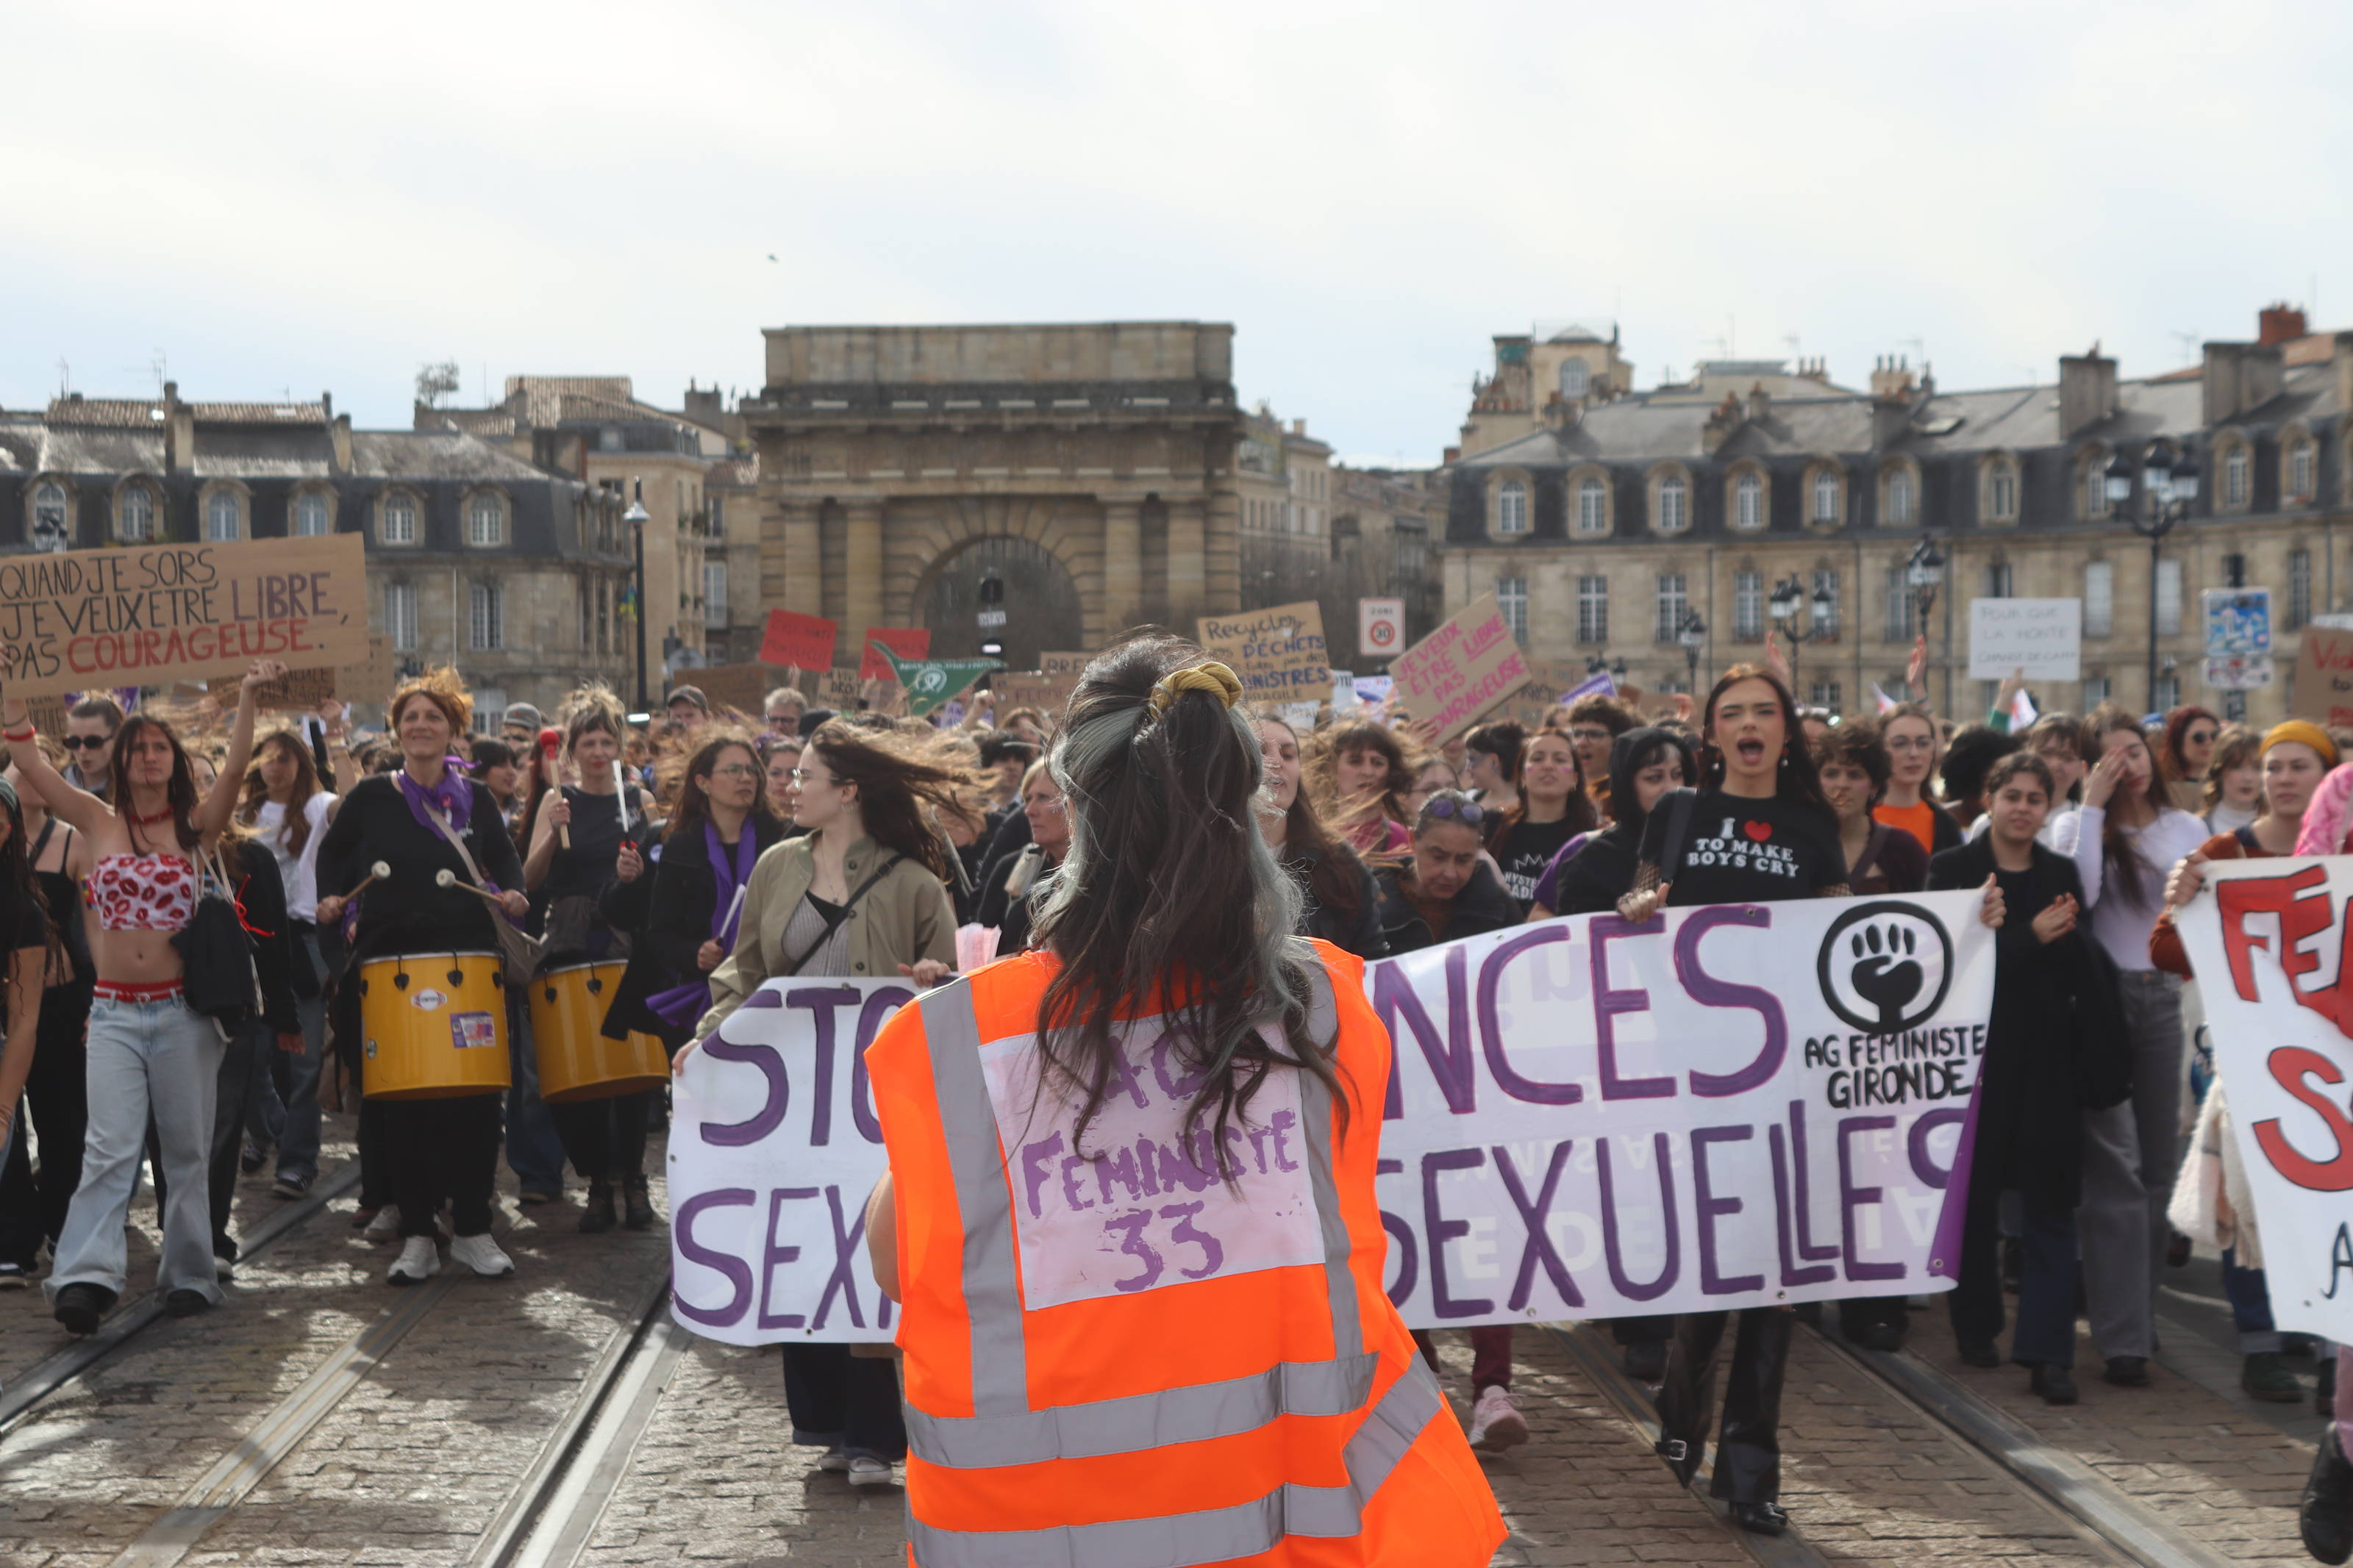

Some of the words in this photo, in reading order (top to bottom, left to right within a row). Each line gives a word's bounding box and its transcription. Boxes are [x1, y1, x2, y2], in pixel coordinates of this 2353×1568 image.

[0, 559, 82, 600] QUAND
[87, 556, 132, 594] JE
[1, 601, 56, 640] JE
[54, 593, 143, 636] VEUX
[1377, 627, 1392, 640] 30
[1243, 635, 1325, 659] DÉCHETS
[1415, 620, 1463, 661] VEUX
[6, 638, 60, 680] PAS
[1433, 671, 1465, 703] PAS
[1720, 817, 1735, 840] I
[1688, 851, 1747, 868] BOYS
[1754, 857, 1800, 878] CRY
[1696, 838, 1725, 852] TO
[1732, 840, 1793, 862] MAKE
[1805, 1034, 1840, 1068] AG
[1827, 1059, 1975, 1109] GIRONDE
[1104, 1200, 1224, 1292] 33
